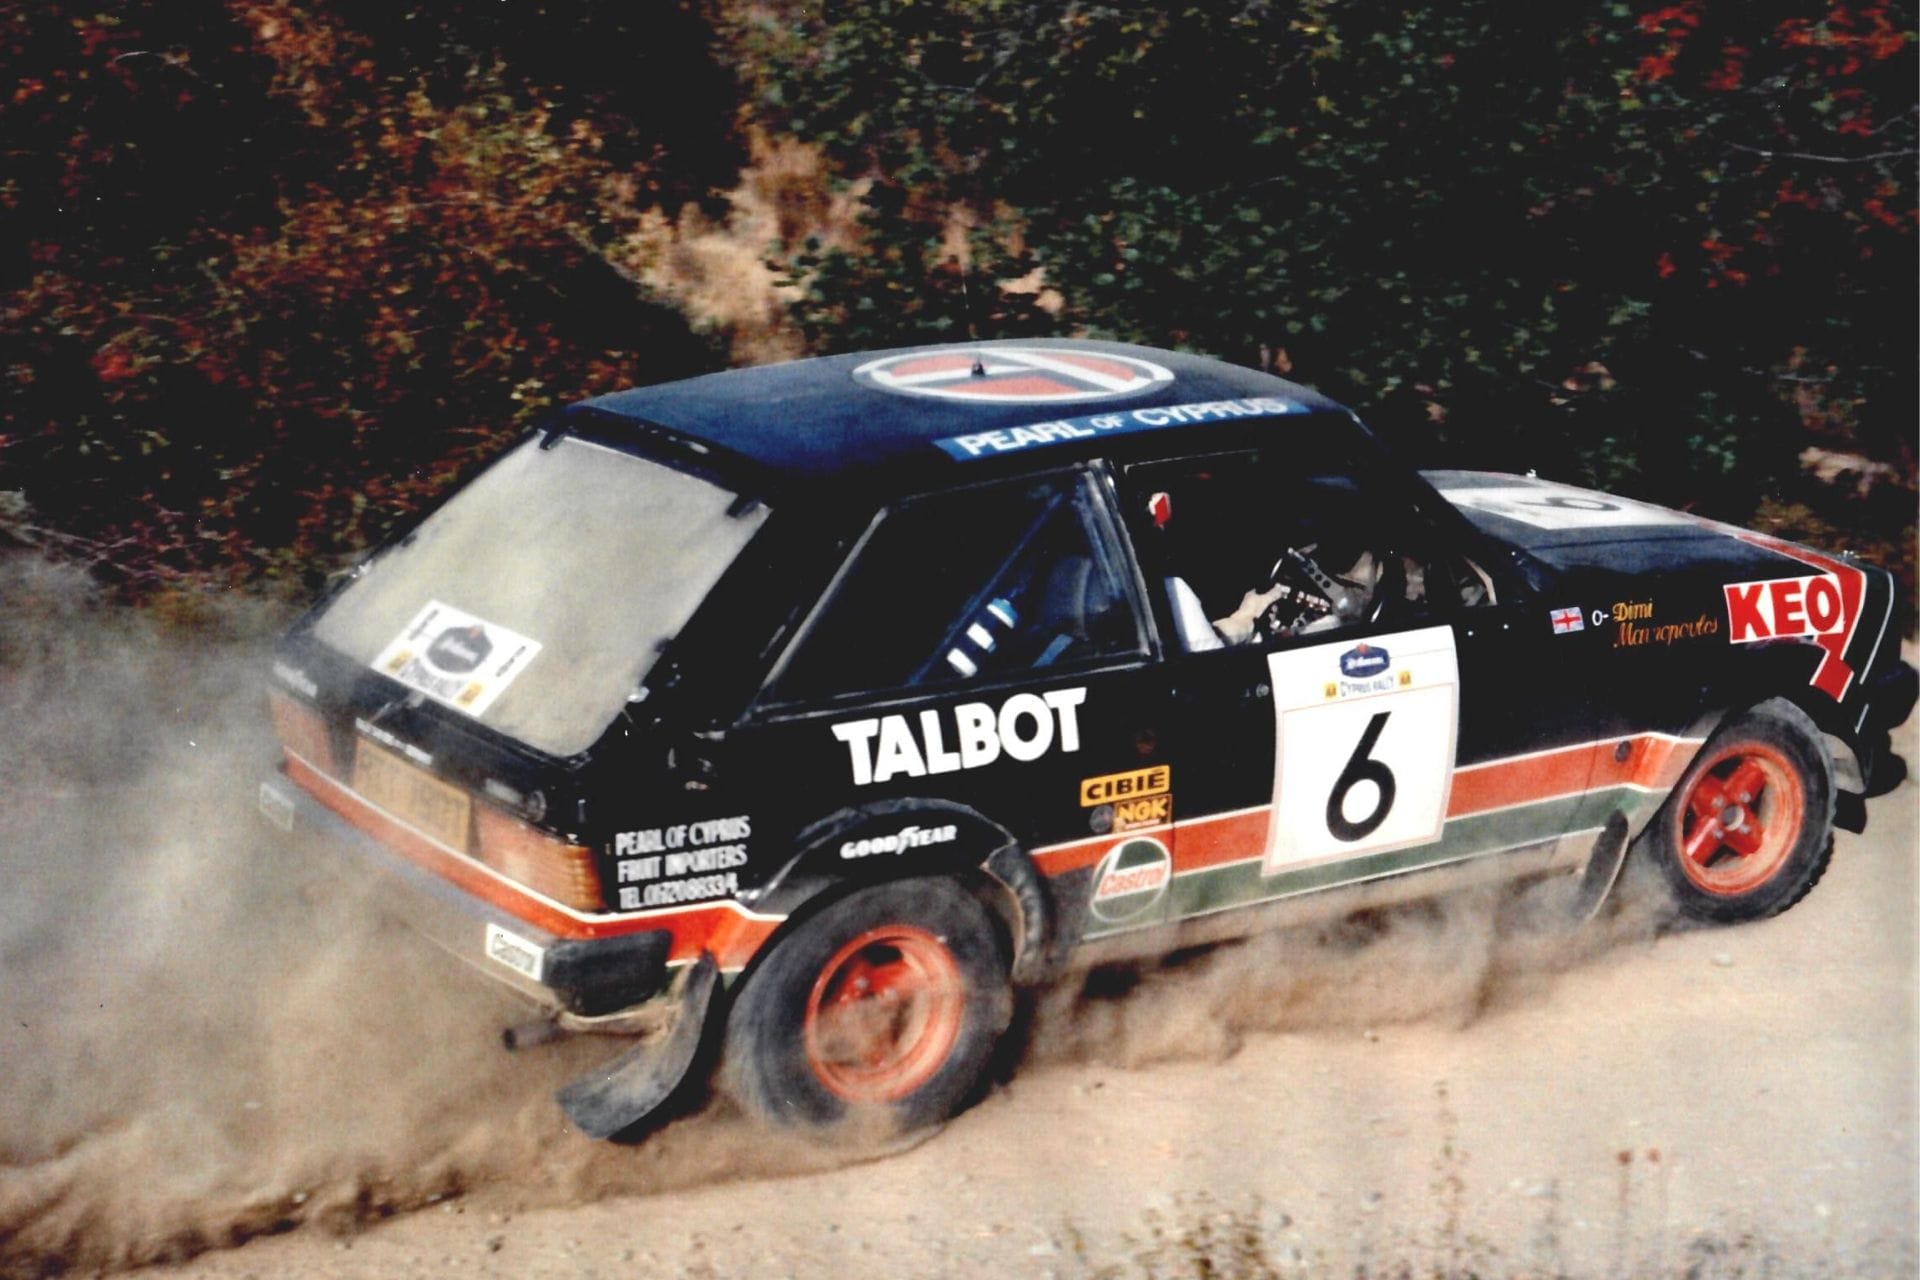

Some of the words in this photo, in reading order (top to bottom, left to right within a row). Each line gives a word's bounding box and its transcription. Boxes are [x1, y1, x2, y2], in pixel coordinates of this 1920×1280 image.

[954, 420, 1095, 456] PEARL
[1090, 414, 1124, 430] OF
[1132, 398, 1289, 426] CYPRUS
[1611, 597, 1655, 624] Dimi
[1725, 575, 1843, 642] KEO
[830, 687, 1087, 785] TALBOT
[1325, 711, 1397, 843] 6
[1117, 798, 1169, 823] NGK
[615, 828, 667, 856] PEARL
[665, 824, 688, 848] OF
[688, 815, 752, 846] CYPRUS
[839, 825, 958, 860] GOODYEAR
[664, 844, 748, 877] IMPORTERS
